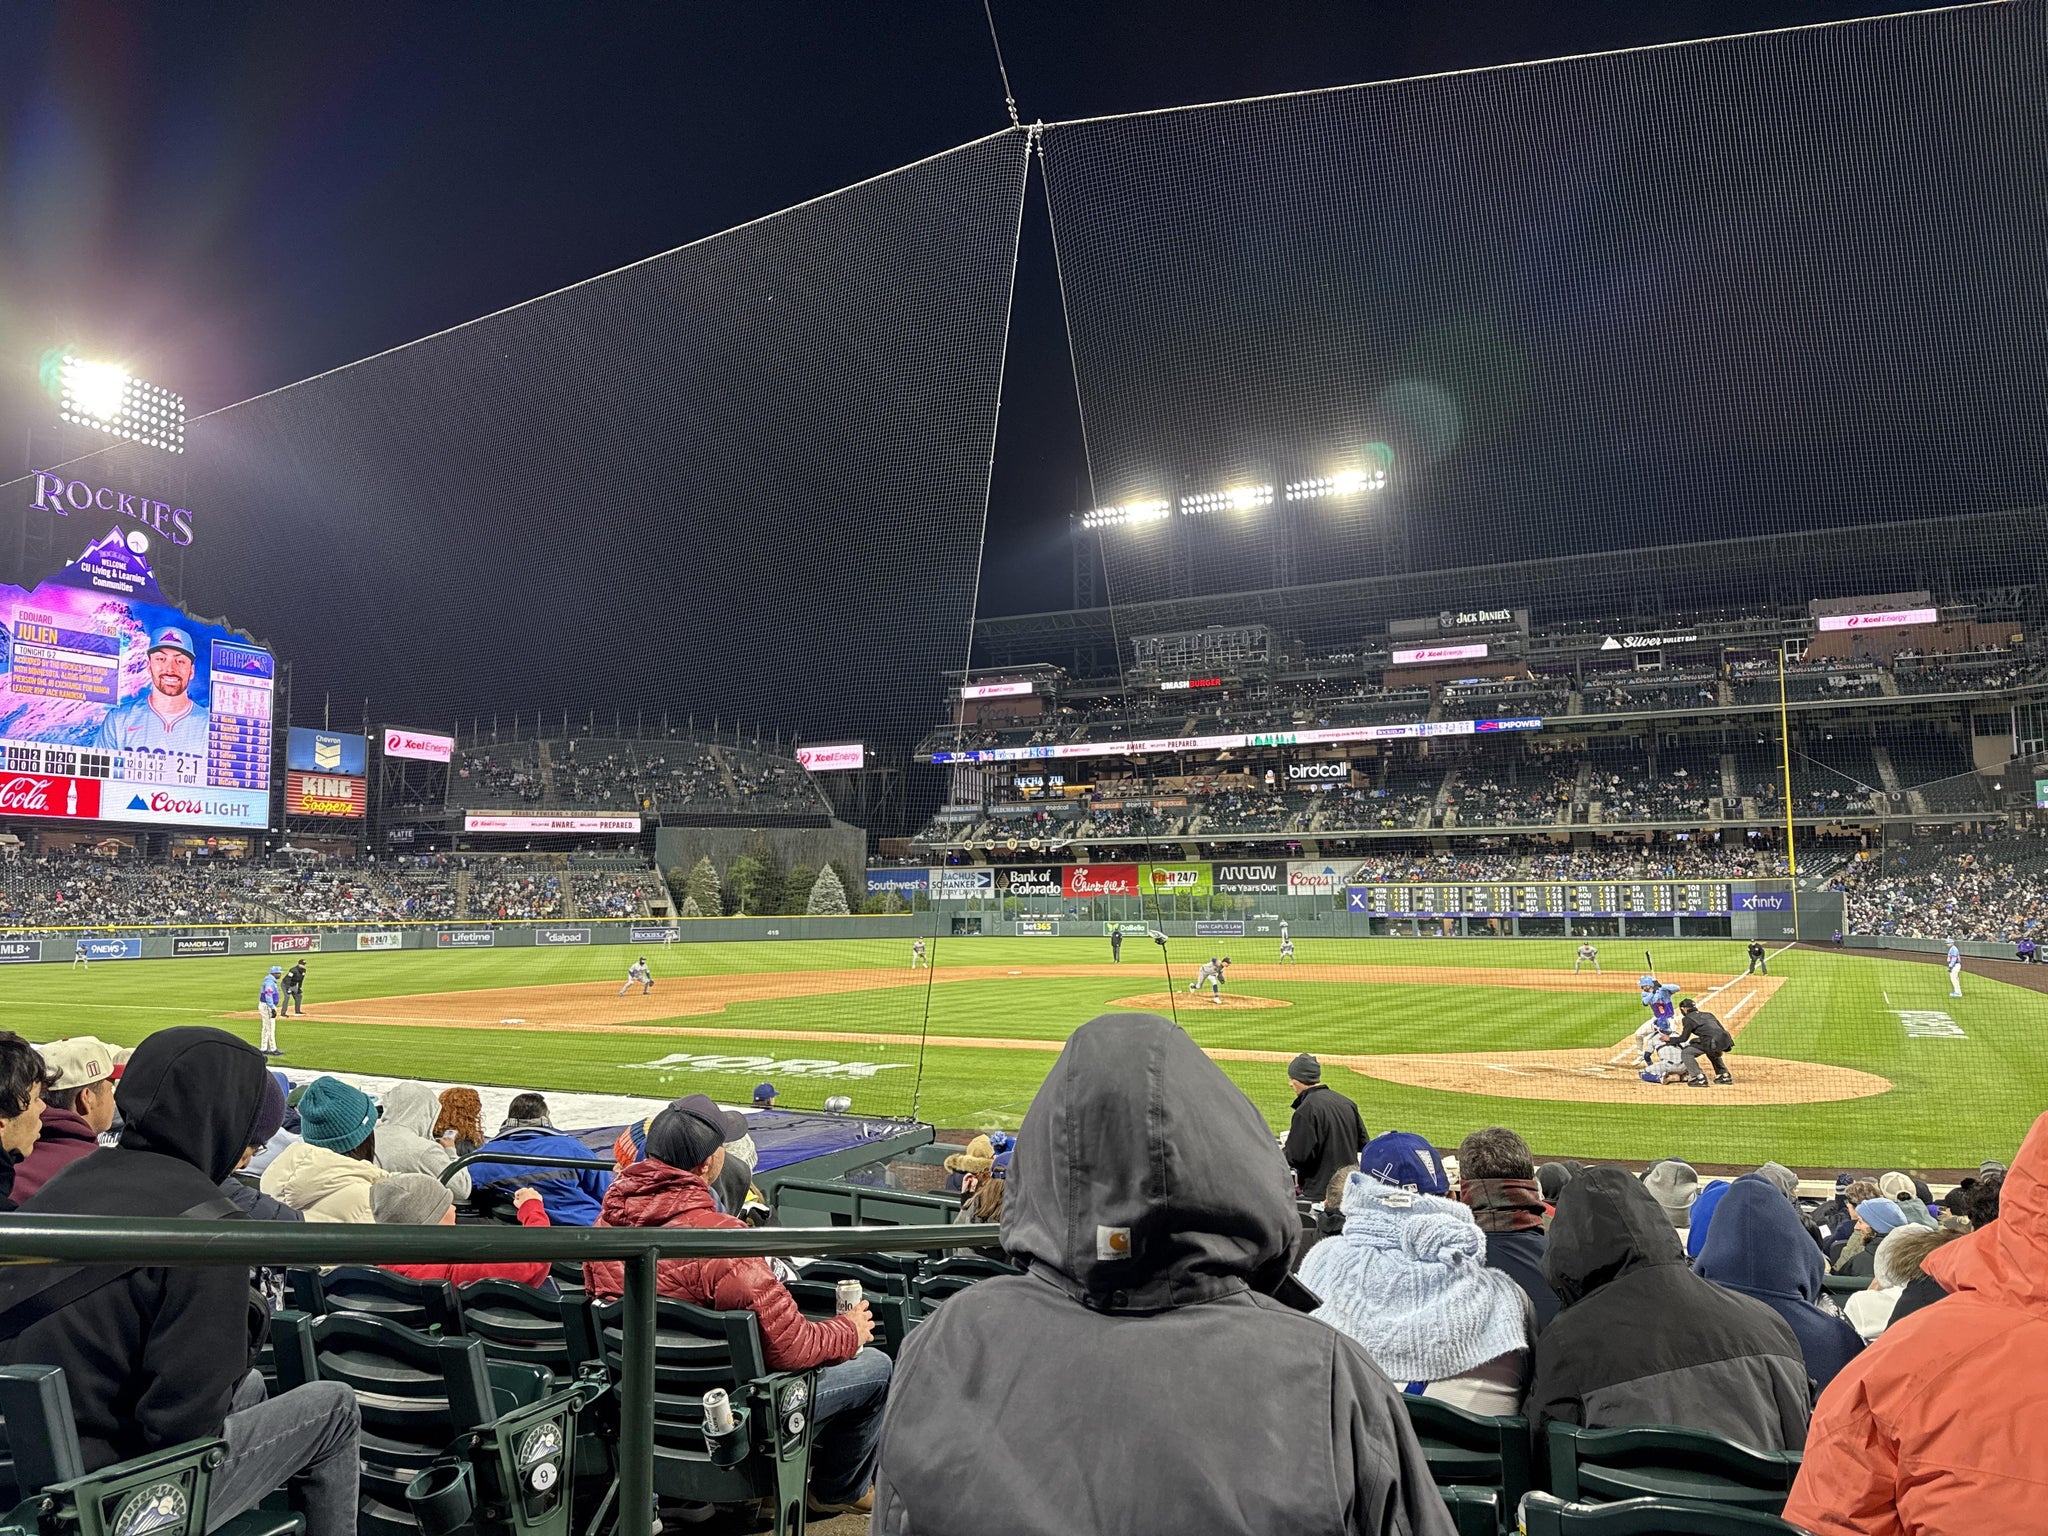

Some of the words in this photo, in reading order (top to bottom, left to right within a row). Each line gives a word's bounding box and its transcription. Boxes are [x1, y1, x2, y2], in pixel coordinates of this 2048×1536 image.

[29, 469, 195, 546] ROCKIES
[101, 558, 127, 571] WELCOME
[81, 562, 91, 572] CU
[92, 564, 111, 579] Living
[112, 568, 117, 578] &
[118, 569, 146, 586] Learning
[92, 576, 134, 593] Communities
[19, 610, 53, 625] EDOUARD
[1456, 612, 1478, 624] JACK
[1479, 608, 1511, 622] DANIEL'S
[1863, 615, 1881, 624] Xcel
[1882, 614, 1907, 623] Energy
[17, 623, 58, 645] JULIEN
[1623, 636, 1662, 649] Silver
[20, 646, 45, 658] TONIGHT
[1427, 650, 1443, 658] Xcel
[1161, 678, 1221, 690] SMASHBURGER
[1498, 720, 1541, 729] EMPOWER
[316, 735, 341, 744] Chevron
[404, 739, 425, 749] Xcel
[425, 742, 451, 756] Energy
[22, 749, 27, 757] 1
[32, 750, 38, 758] 2
[68, 754, 73, 763] 0
[117, 759, 121, 767] 7
[127, 760, 134, 768] 12
[149, 761, 153, 769] 4
[815, 753, 834, 762] Xcel
[834, 752, 859, 762] Energy
[10, 759, 15, 767] 0
[21, 760, 26, 768] 0
[31, 762, 37, 770] 0
[48, 764, 52, 772] 1
[57, 765, 63, 773] 0
[137, 771, 142, 779] 0
[148, 772, 153, 780] 3
[1289, 762, 1347, 779] birdcall
[184, 774, 197, 784] OUT
[1014, 776, 1044, 787] FLECHA
[302, 777, 353, 798] KING
[151, 792, 203, 814] Coors
[205, 801, 249, 817] LIGHT
[301, 795, 353, 815] Soopers
[1577, 802, 1584, 811] A
[1728, 798, 1736, 808] D
[1436, 808, 1442, 817] R
[551, 821, 576, 829] AWARE.
[599, 821, 635, 829] PREPARED.
[389, 830, 413, 839] PLATTE
[943, 872, 976, 880] BACHUS
[1010, 870, 1037, 882] Bank
[1039, 869, 1051, 882] of
[1177, 871, 1197, 882] 24/7
[1219, 866, 1277, 880] ARROW
[1290, 871, 1329, 886] Coors
[1331, 875, 1350, 885] LIG
[867, 880, 919, 891] Southwest
[931, 881, 976, 889] SCHANKER
[1010, 881, 1061, 895] Colorado
[1237, 884, 1259, 892] Years
[1260, 884, 1277, 892] Out
[1742, 894, 1783, 909] xfinity
[1023, 921, 1052, 930] bet365
[375, 935, 387, 944] 24/7
[452, 932, 490, 942] Lifetime
[549, 932, 582, 943] dialpad
[1, 944, 31, 954] MLB+
[178, 940, 206, 948] RAMOS
[207, 939, 224, 947] LAW
[644, 1053, 915, 1076] YORK
[793, 1416, 800, 1429] 8
[540, 1470, 549, 1484] 9
